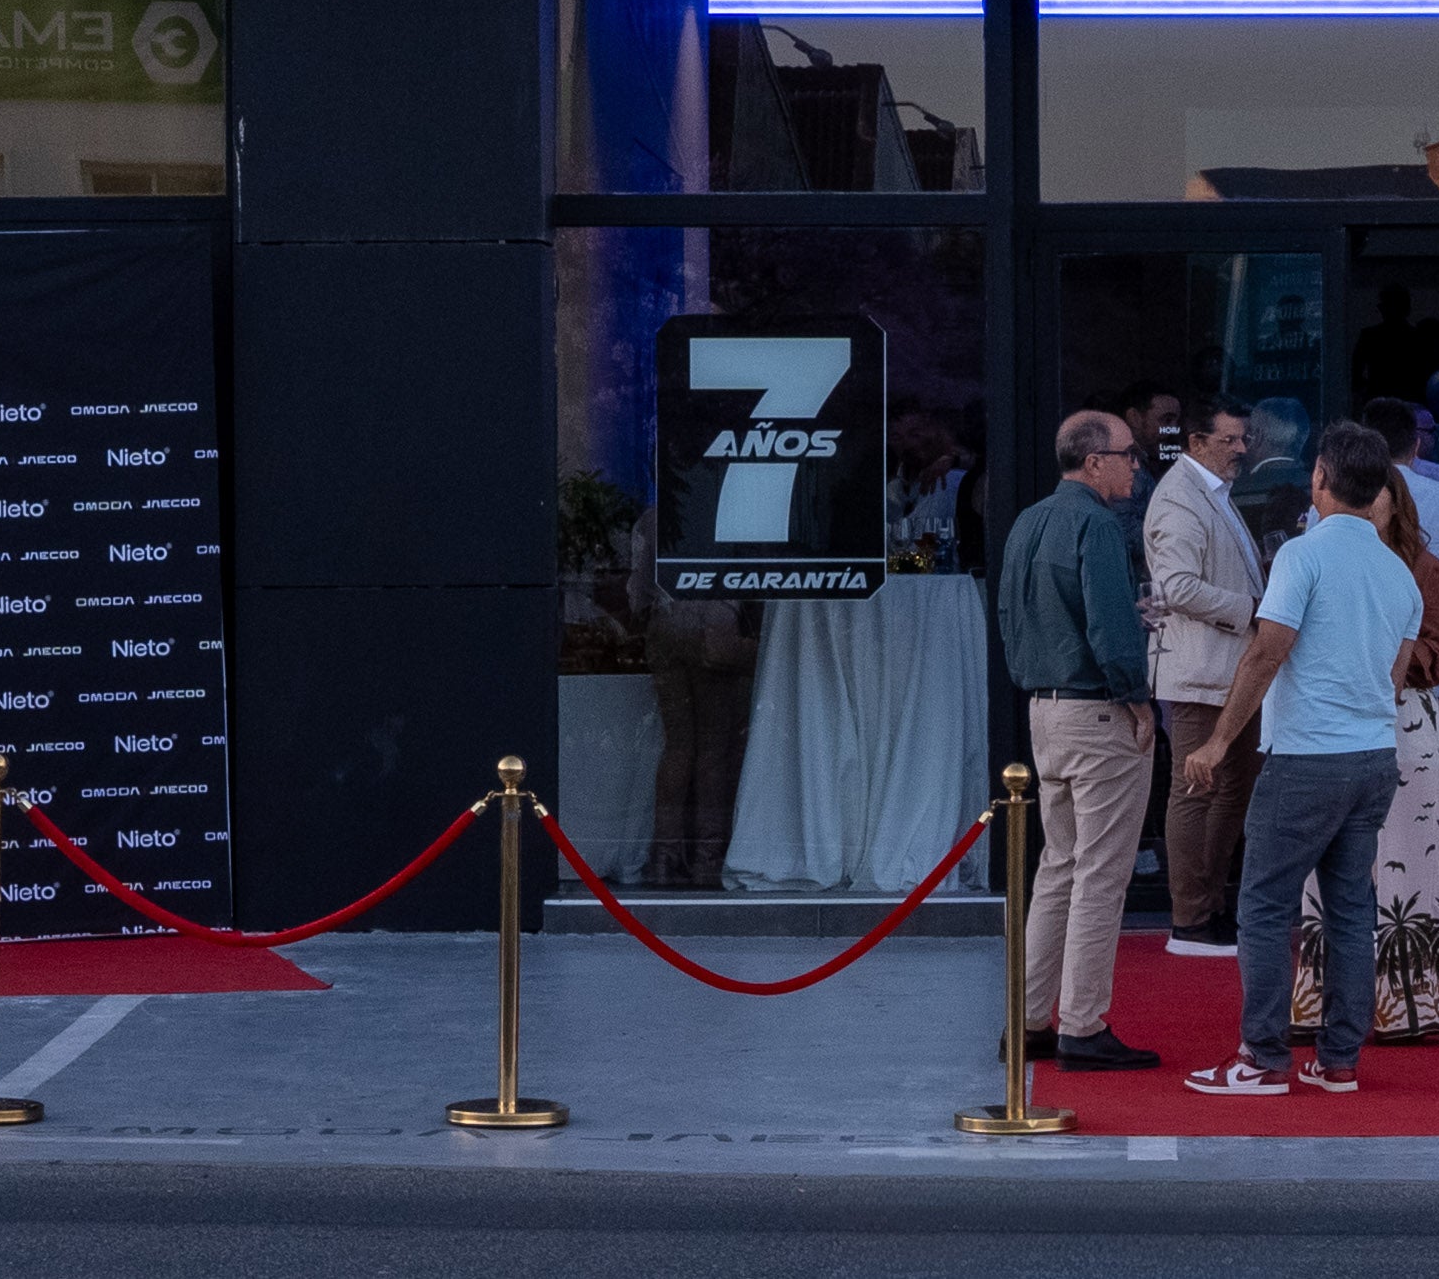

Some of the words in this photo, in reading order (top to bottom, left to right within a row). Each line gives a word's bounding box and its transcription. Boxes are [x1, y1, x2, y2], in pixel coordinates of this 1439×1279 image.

[70, 404, 131, 416] OMODA
[139, 402, 199, 414] JAECOO
[689, 337, 852, 542] 7
[702, 421, 844, 459] AÑOS
[17, 454, 78, 466] JAECOO
[73, 500, 133, 512] OMODA
[141, 497, 201, 509] JAECOO
[20, 550, 80, 561] JAECOO
[675, 571, 713, 591] DE
[721, 565, 869, 591] GARANTÍA
